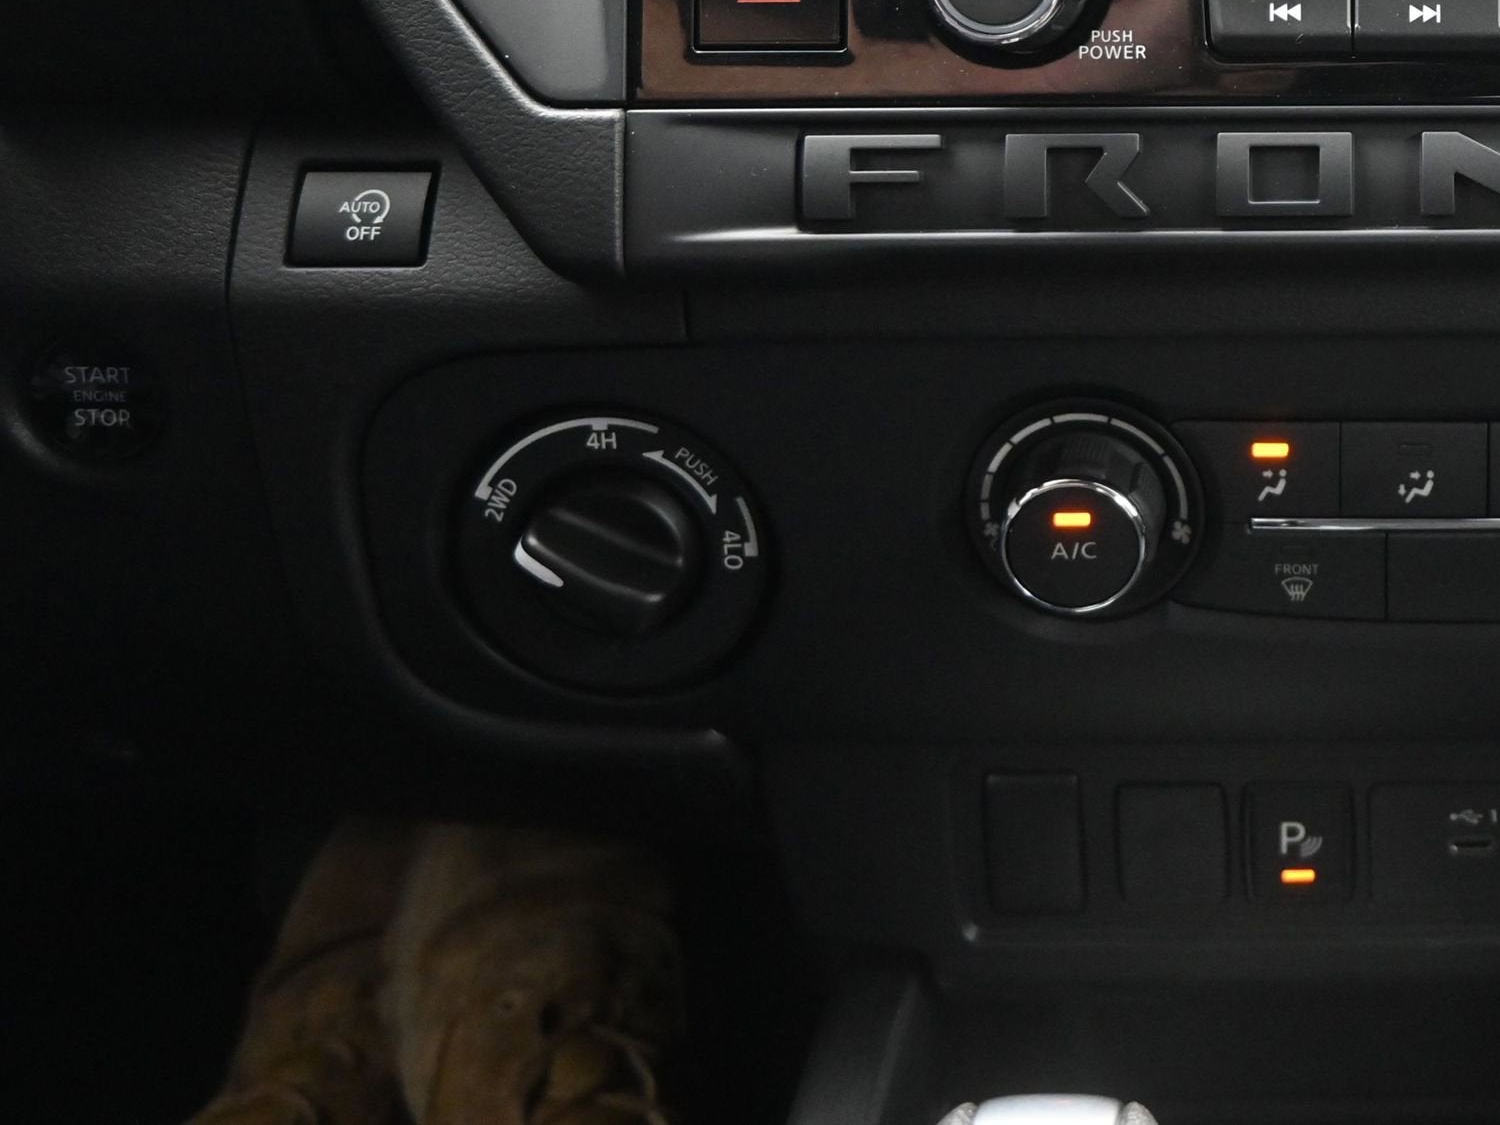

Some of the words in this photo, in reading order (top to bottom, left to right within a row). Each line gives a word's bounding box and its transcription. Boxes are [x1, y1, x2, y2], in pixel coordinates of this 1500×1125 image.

[1091, 29, 1133, 43] PUSH
[1078, 44, 1147, 60] POWER
[339, 200, 381, 215] AUTO
[345, 225, 382, 242] OFF
[63, 366, 131, 384] START
[73, 389, 127, 403] ENGINE
[73, 408, 131, 427] STOP
[586, 431, 617, 450] 4H
[674, 446, 719, 487] PUSH
[484, 477, 518, 523] 2WD
[722, 529, 744, 571] 4LO
[1051, 541, 1097, 560] A/C
[1274, 563, 1320, 575] FRONT
[1281, 821, 1304, 855] P
